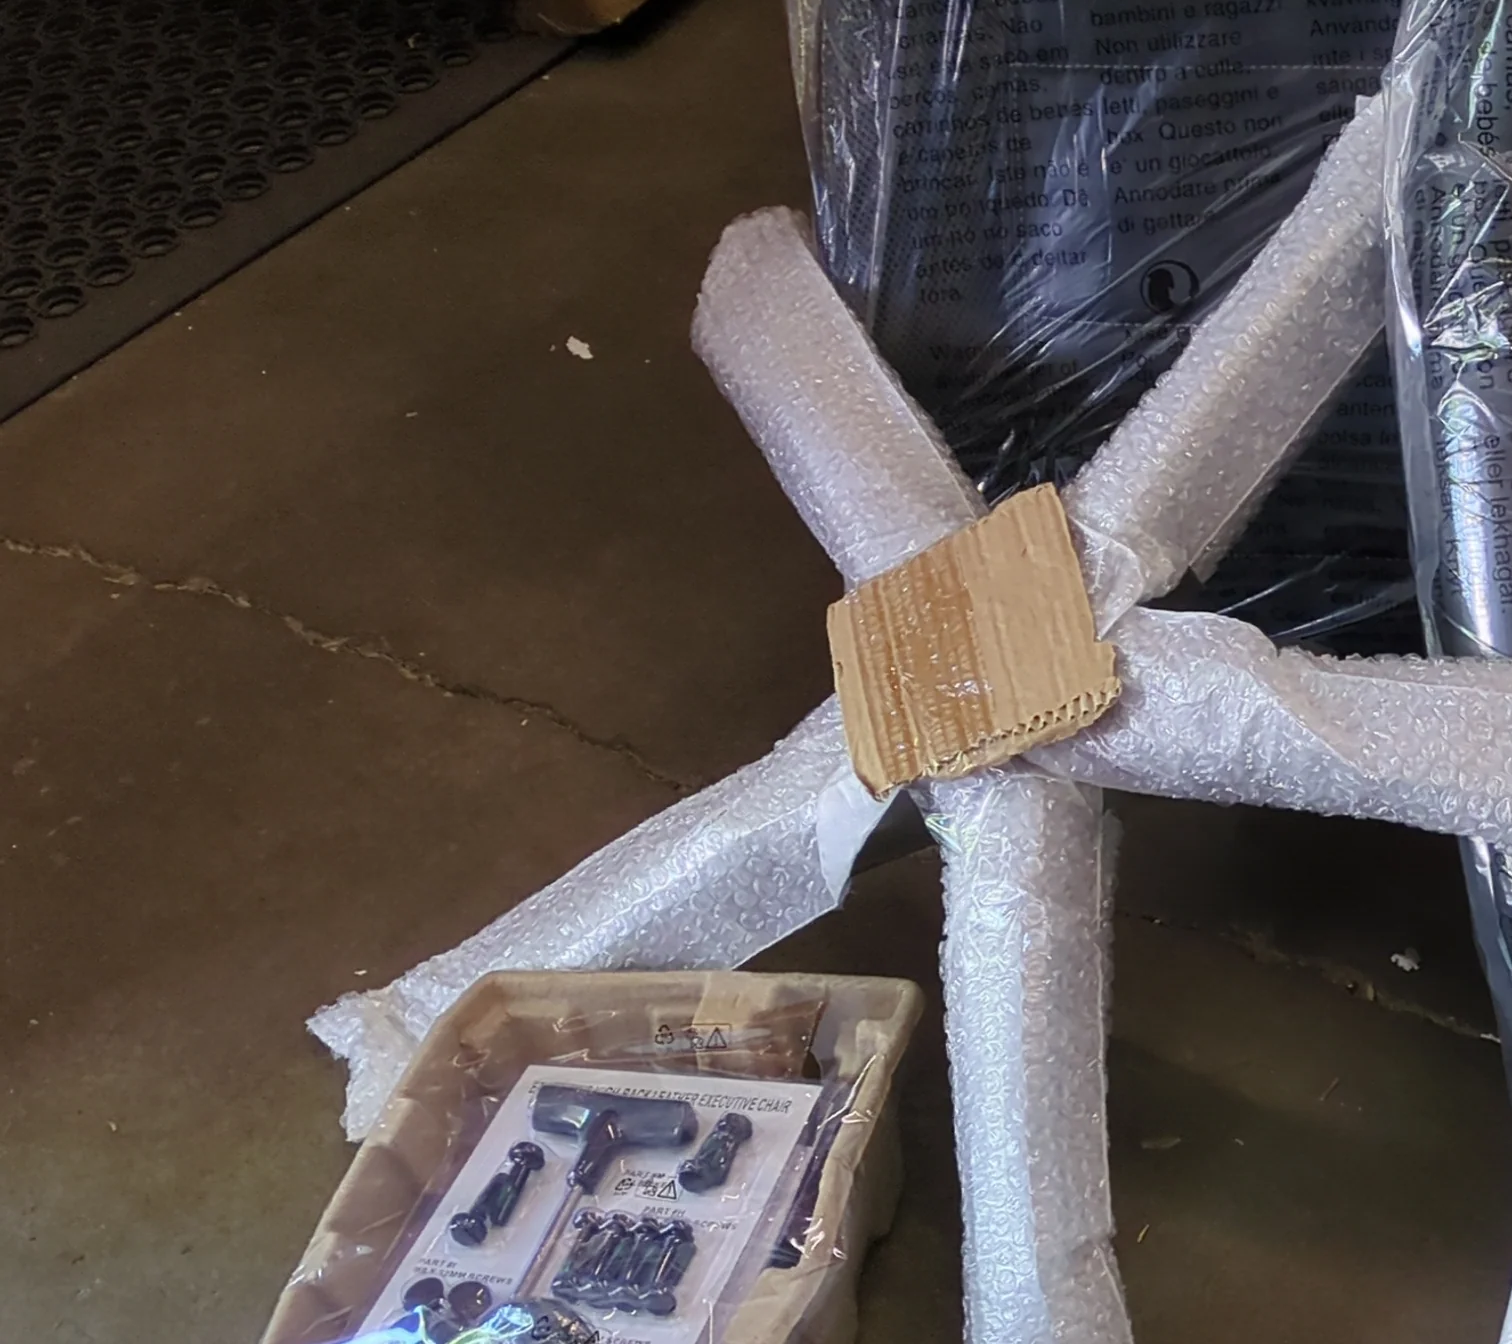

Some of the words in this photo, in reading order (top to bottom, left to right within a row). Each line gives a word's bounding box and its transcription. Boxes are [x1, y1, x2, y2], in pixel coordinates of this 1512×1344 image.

[1090, 2, 1175, 26] bambini
[1183, 5, 1196, 19] e
[1094, 36, 1138, 55] Non
[1147, 29, 1242, 52] utilizzare
[1158, 120, 1237, 141] Questo
[1244, 114, 1283, 131] non
[699, 1092, 759, 1111] EXECUTIVE
[756, 1096, 793, 1114] CHAIR
